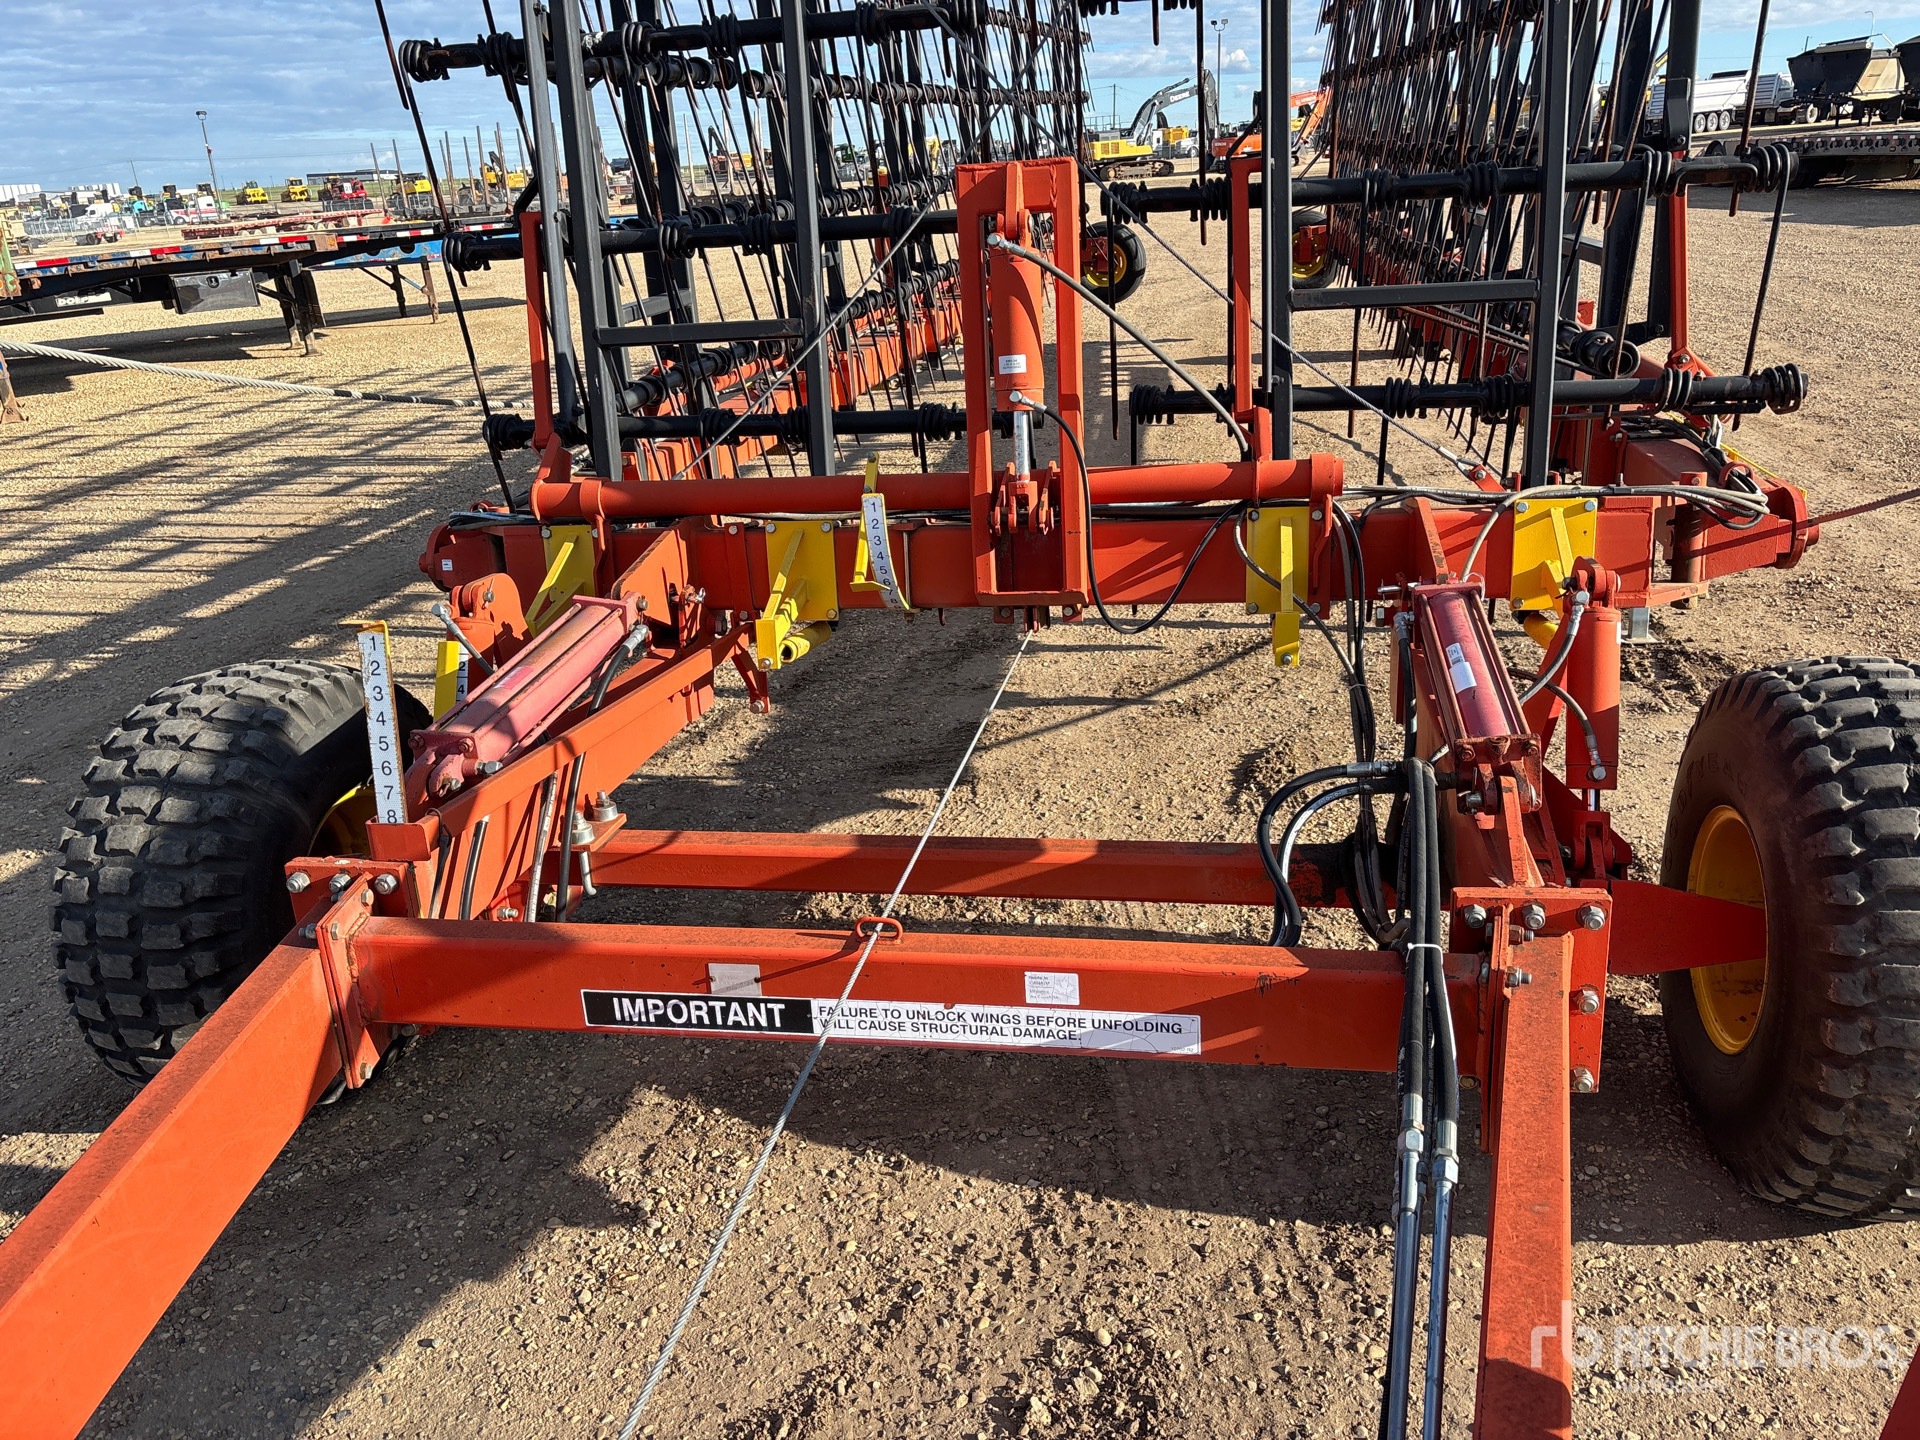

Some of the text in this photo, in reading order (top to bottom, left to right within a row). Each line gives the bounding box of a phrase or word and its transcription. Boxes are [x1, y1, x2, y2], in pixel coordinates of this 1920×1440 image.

[870, 502, 876, 512] 1
[872, 519, 879, 529] 2
[874, 536, 881, 545] 3
[877, 552, 884, 560] 4
[880, 566, 887, 574] 5
[883, 578, 891, 586] 6
[369, 635, 376, 651] 1
[370, 660, 381, 676] 2
[457, 661, 466, 672] 2
[373, 685, 384, 702] 3
[457, 685, 465, 695] 4
[376, 711, 387, 726] 4
[379, 735, 389, 751] 5
[381, 760, 393, 776] 6
[384, 785, 394, 800] 7
[387, 809, 398, 824] 8
[612, 996, 787, 1028] IMPORTANT
[819, 1006, 1183, 1034] FALURE TO UNLOCK WINGS BEFORE UNFOLDING
[858, 1020, 906, 1032] CAUSE
[911, 1022, 1009, 1037] STRUCTURAL
[1013, 1027, 1082, 1041] DAMAGE.
